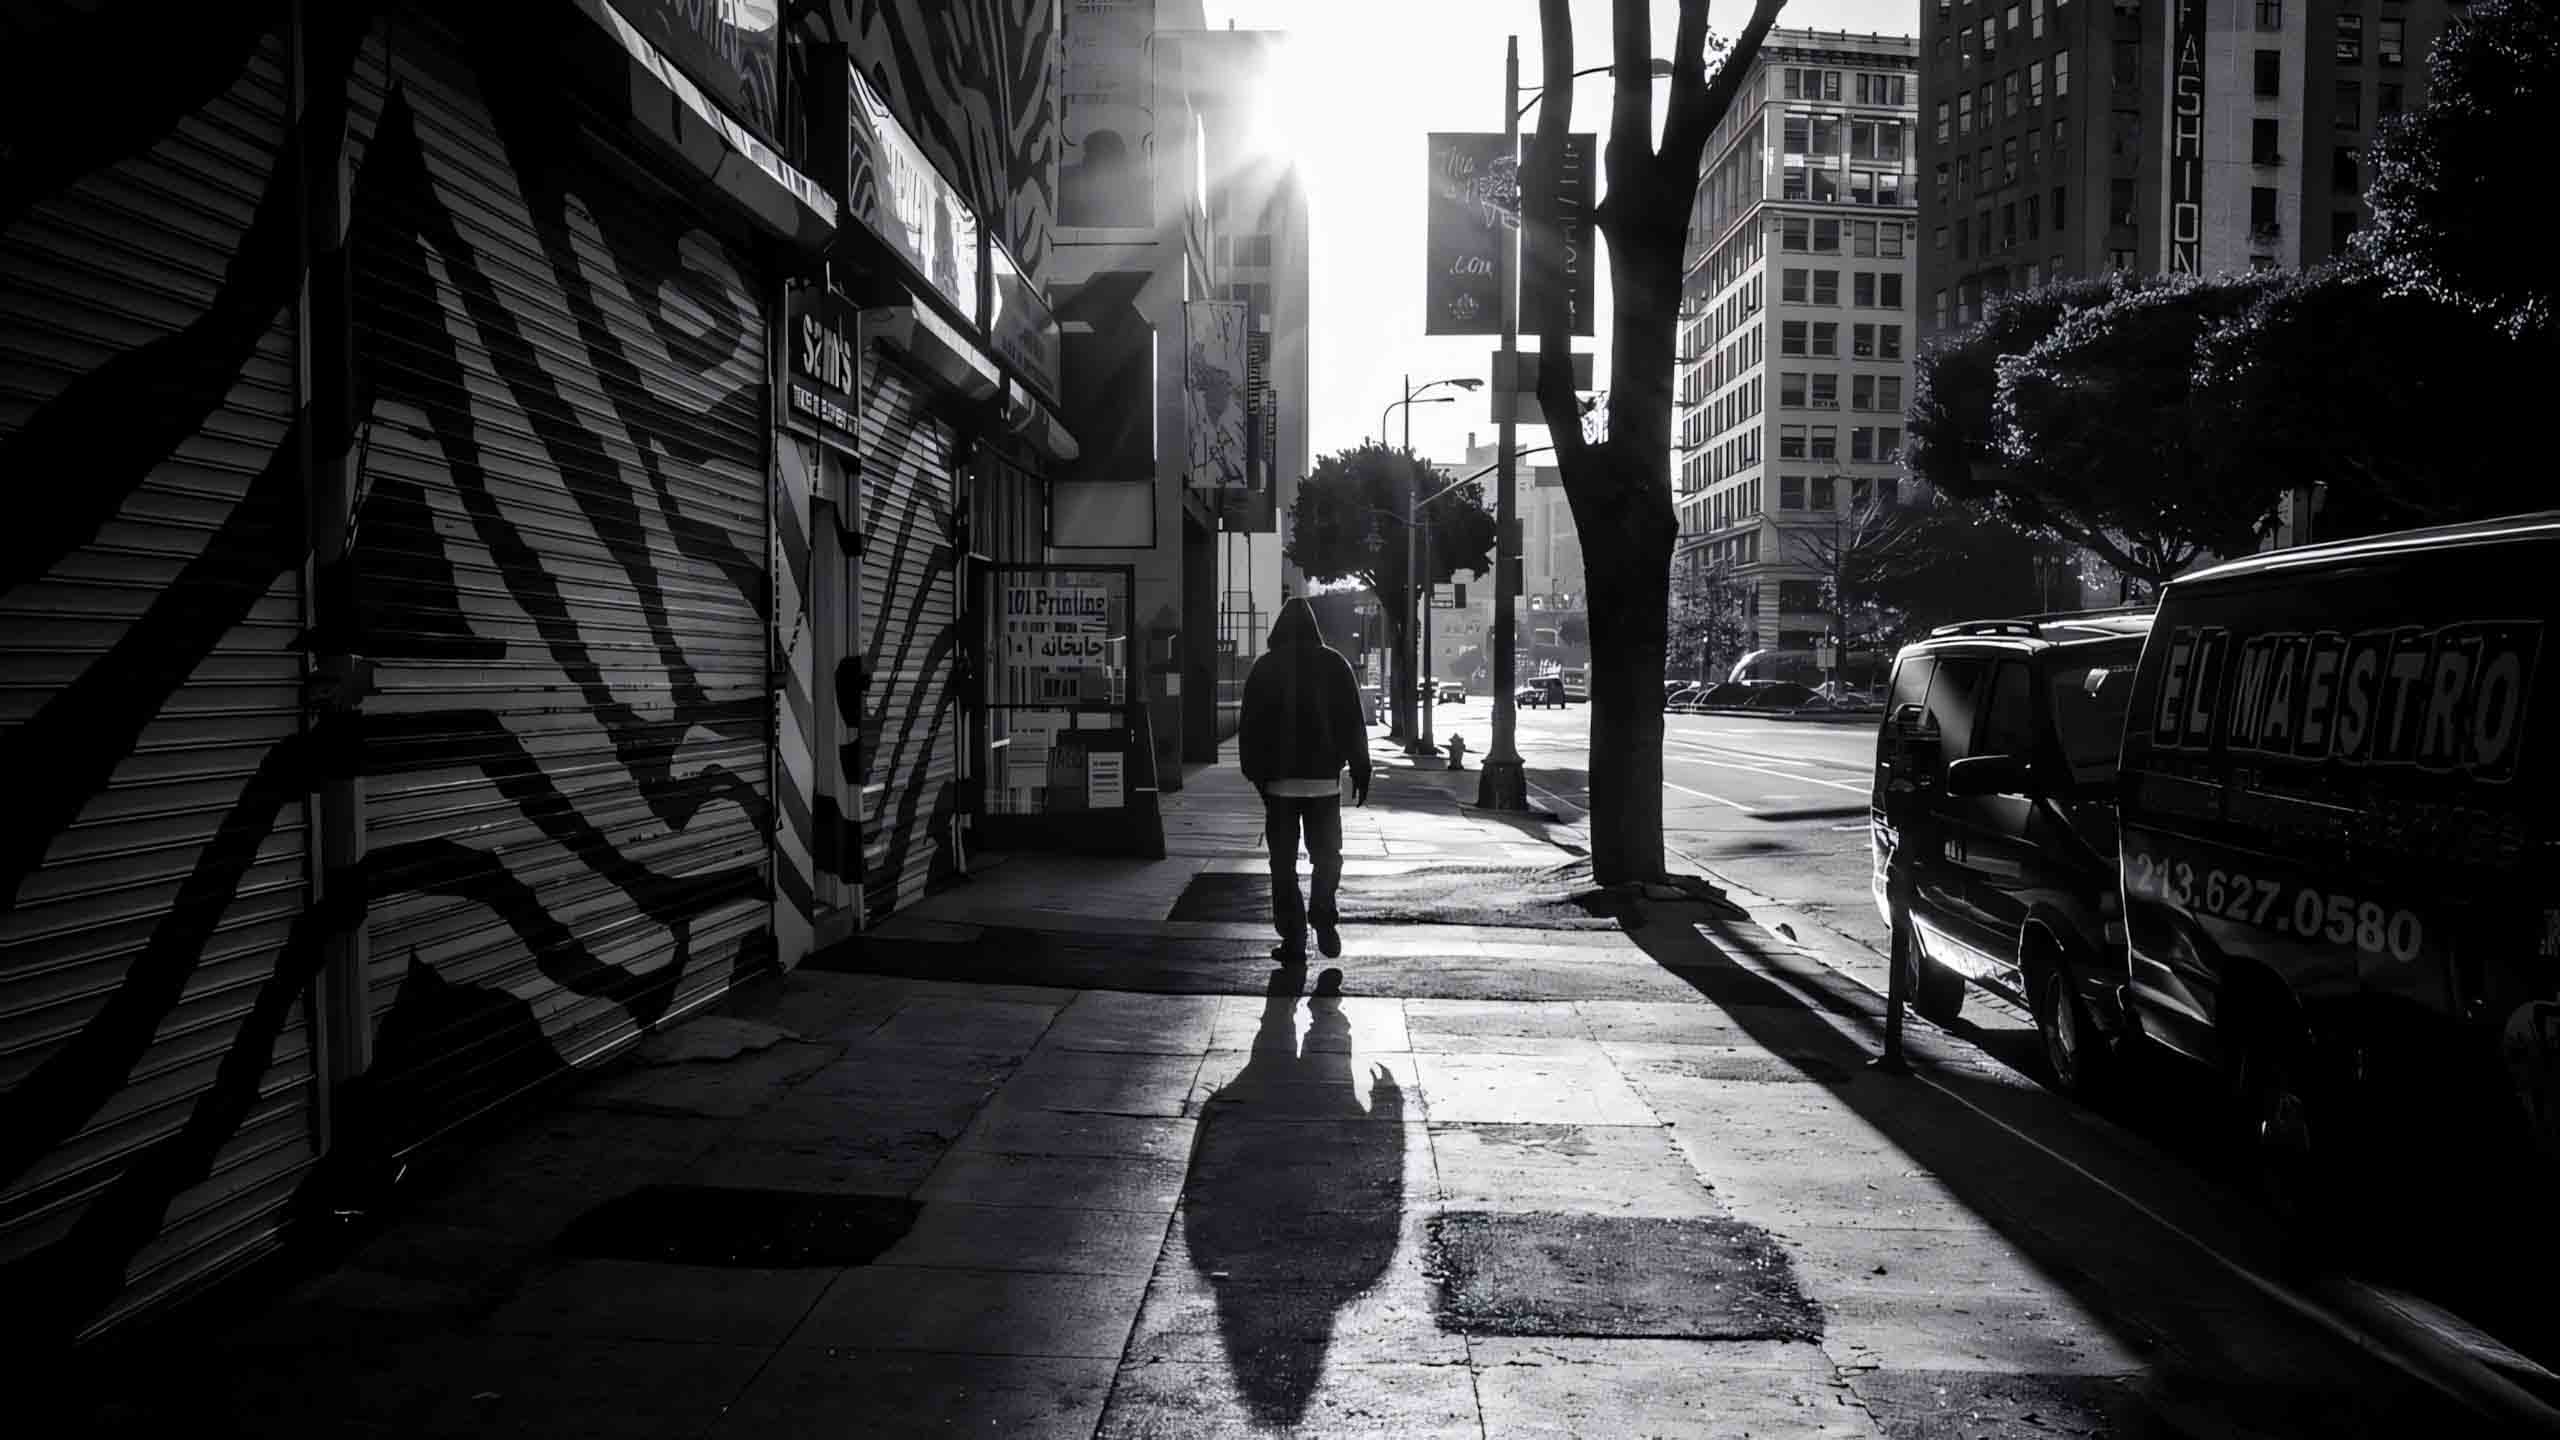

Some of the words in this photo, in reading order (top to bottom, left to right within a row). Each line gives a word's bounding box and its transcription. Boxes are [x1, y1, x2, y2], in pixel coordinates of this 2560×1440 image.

[2174, 0, 2201, 277] FASHION
[1036, 590, 1105, 622] Printing
[2156, 636, 2218, 740] EL
[2230, 640, 2525, 770] MAESTRO
[2127, 853, 2422, 962] 213.627.0580
